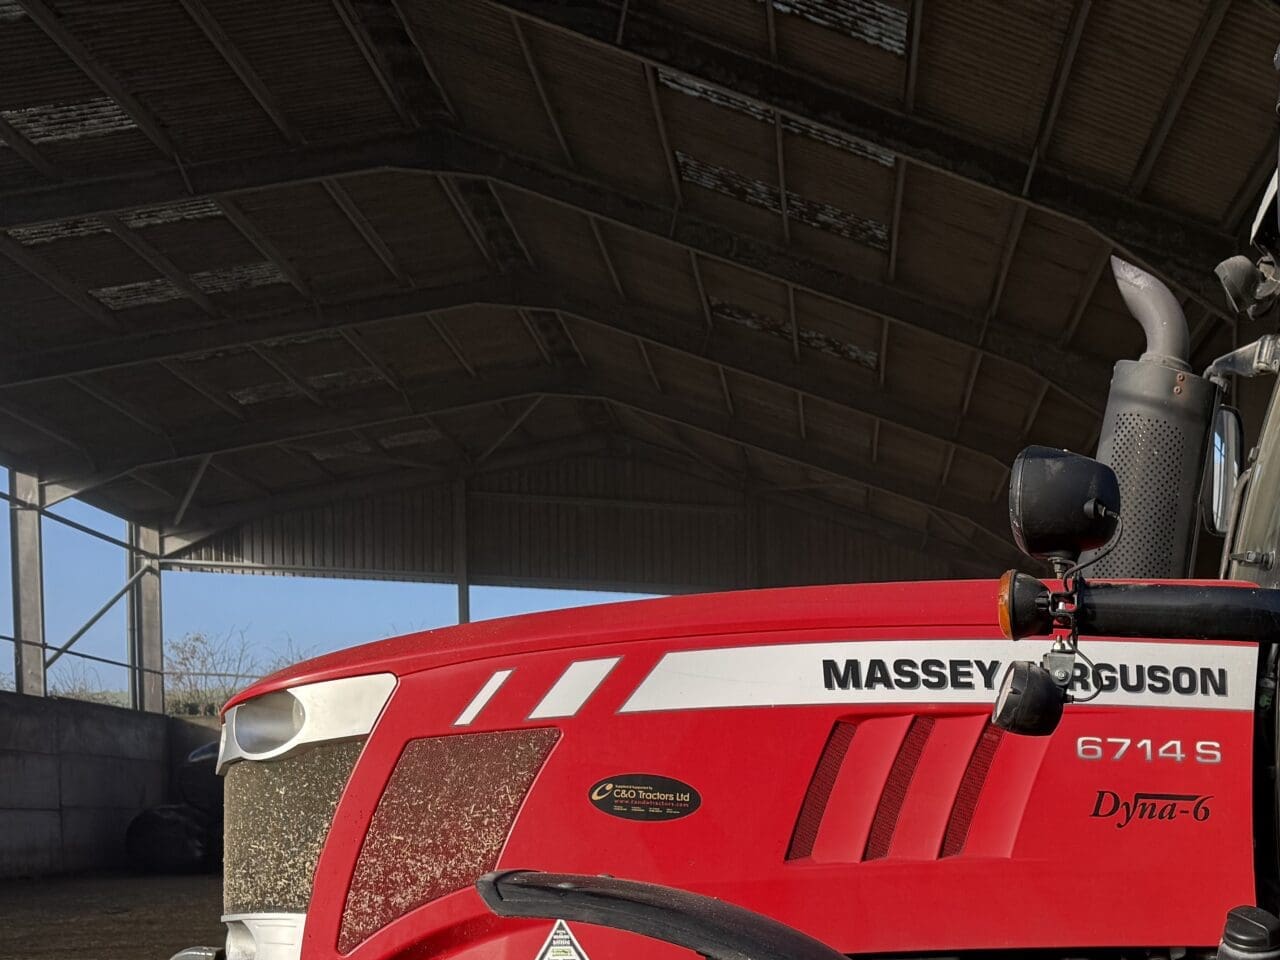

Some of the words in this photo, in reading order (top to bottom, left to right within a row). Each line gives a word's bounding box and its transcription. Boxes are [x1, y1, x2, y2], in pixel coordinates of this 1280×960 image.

[822, 659, 1000, 690] MASSEY
[1042, 662, 1228, 696] RGUSON
[1077, 736, 1186, 761] 6714
[1195, 741, 1221, 763] S
[613, 789, 636, 799] C&O
[638, 790, 674, 801] Tractors
[676, 792, 690, 802] Ltd
[1089, 790, 1214, 828] Dyna-6
